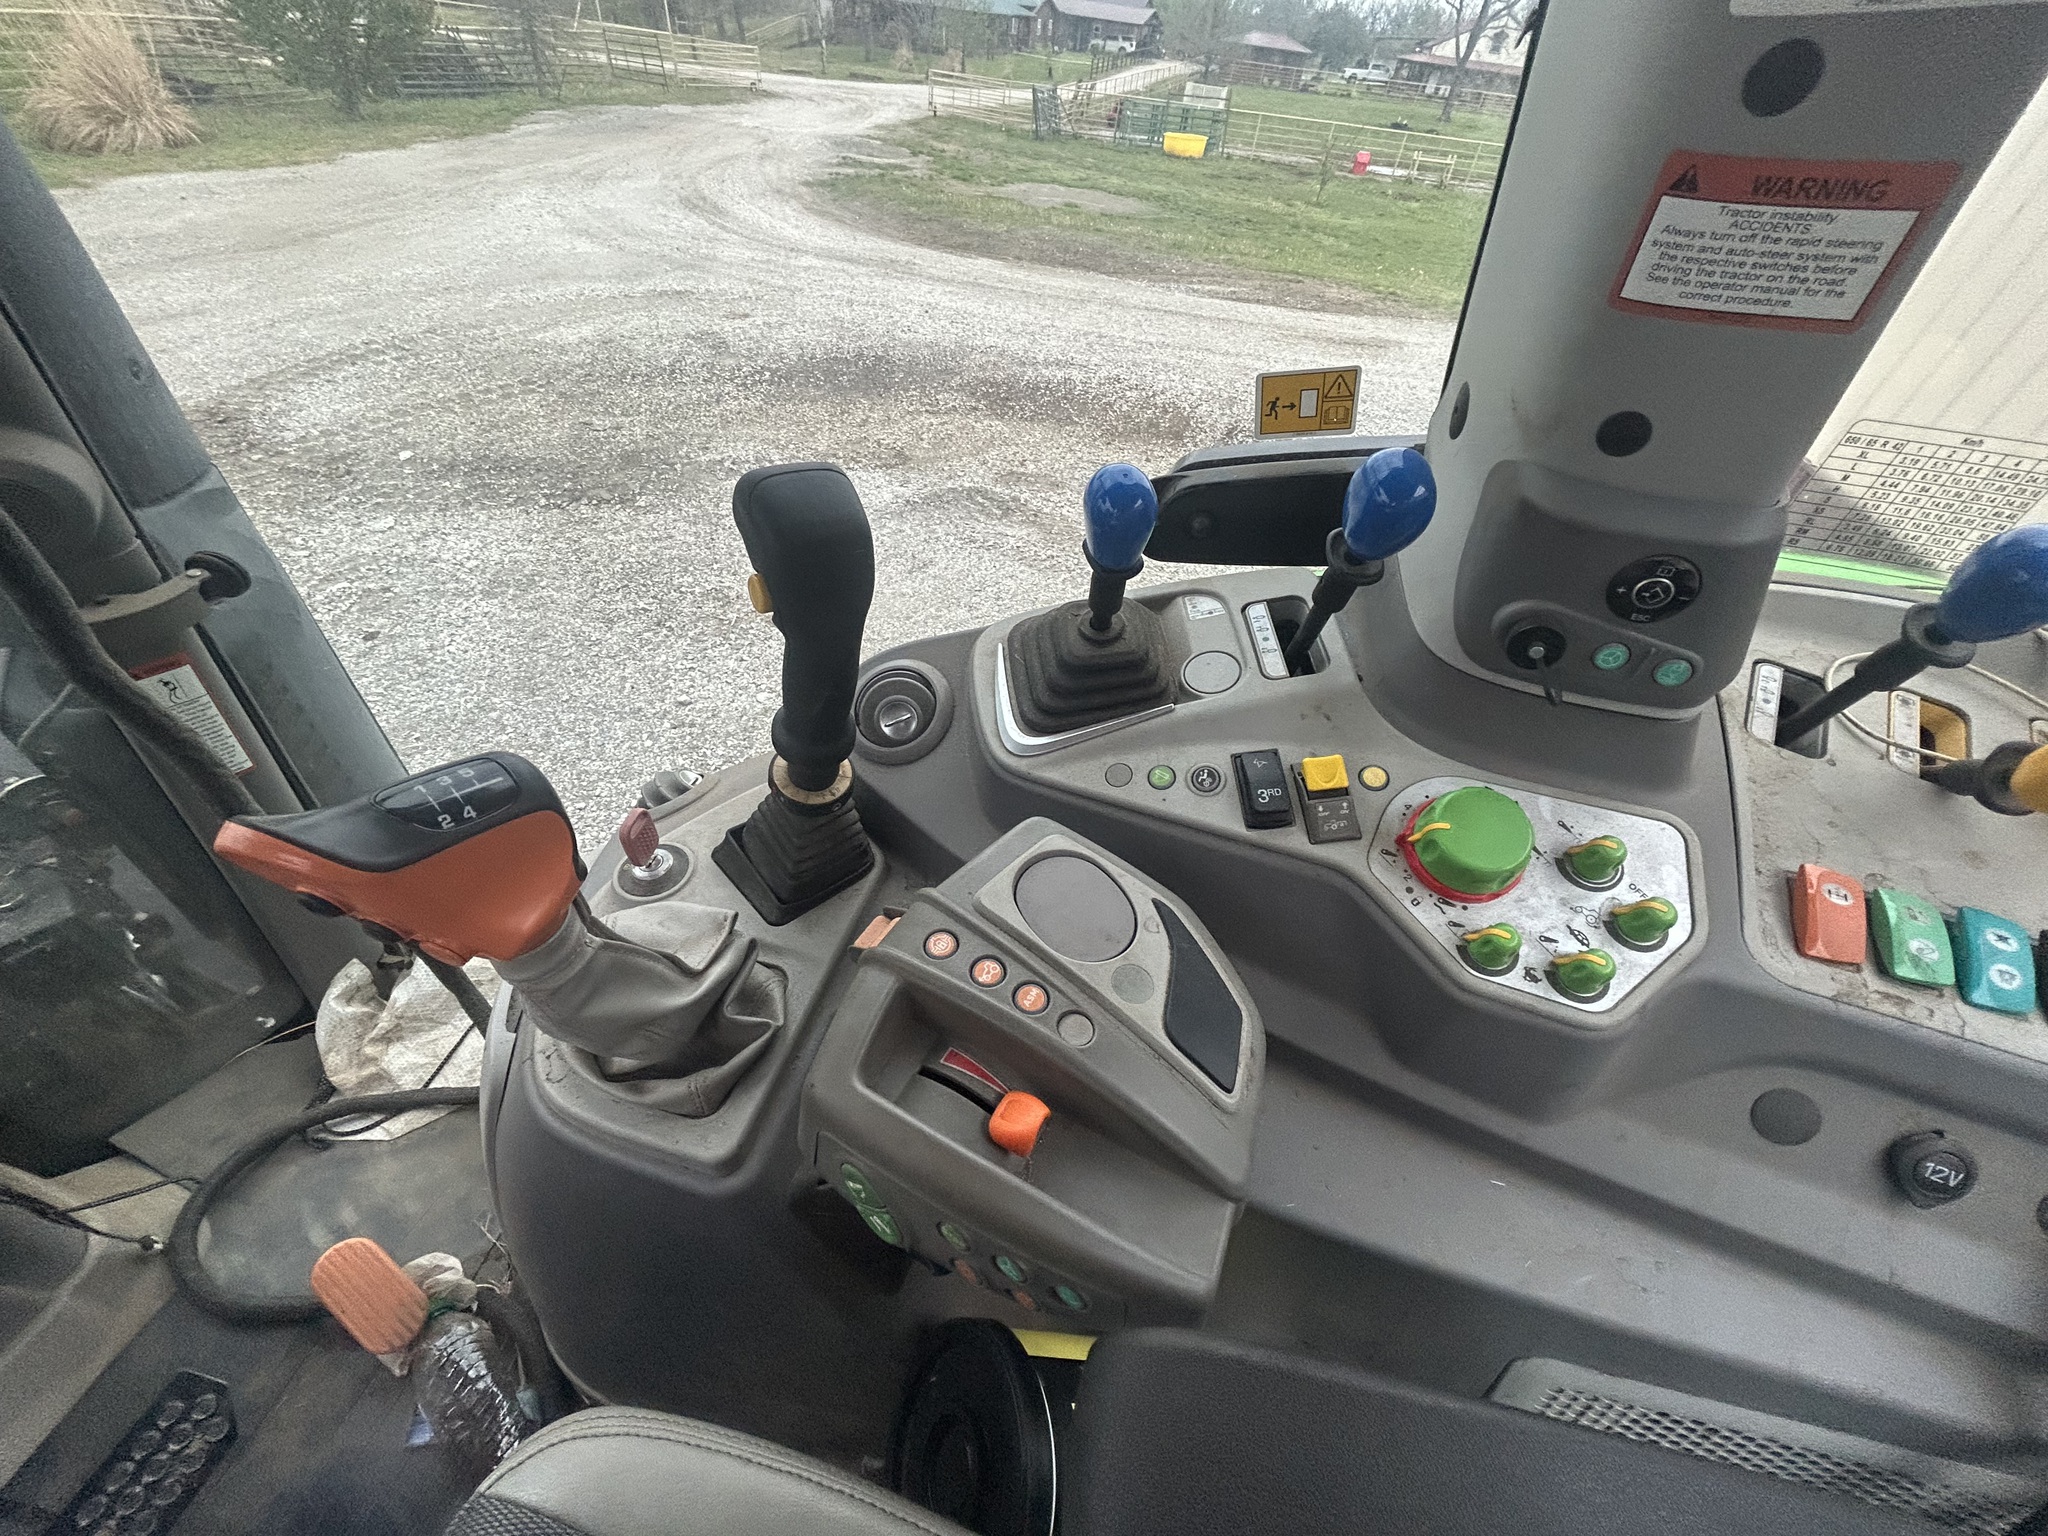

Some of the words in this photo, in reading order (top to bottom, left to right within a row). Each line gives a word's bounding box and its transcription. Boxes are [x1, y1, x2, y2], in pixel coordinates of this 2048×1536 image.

[1751, 175, 1890, 203] WARNING
[1719, 205, 1767, 219] Tractor
[1769, 208, 1840, 226] instability
[1728, 219, 1813, 235] ACCIDENTS
[1661, 224, 1707, 241] Always
[1709, 230, 1736, 242] turn
[1739, 232, 1760, 243] off
[1760, 234, 1783, 246] the
[1786, 236, 1824, 249] rapid
[1824, 239, 1885, 253] steering
[1650, 239, 1695, 251] system
[1696, 244, 1724, 256] and
[1725, 246, 1795, 261] auto-steer
[1796, 250, 1847, 264] system
[1850, 254, 1879, 265] with
[1658, 250, 1679, 262] the
[1680, 255, 1748, 270] respective
[1750, 261, 1810, 274] switches
[1811, 264, 1858, 277] before
[1646, 271, 1669, 284] See
[1671, 275, 1692, 288] the
[1694, 279, 1748, 293] operator
[1749, 284, 1800, 297] manual
[1803, 286, 1823, 298] for
[1824, 288, 1847, 299] the
[1650, 262, 1693, 277] driving
[1695, 267, 1717, 278] the
[1719, 269, 1763, 282] tractor
[1766, 273, 1784, 284] on
[1787, 274, 1810, 286] the
[1812, 277, 1848, 288] road.
[1678, 291, 1723, 303] correct
[1723, 294, 1794, 308] procedure.
[1630, 613, 1651, 622] ESC
[413, 785, 427, 794] 1
[436, 775, 452, 786] 3
[437, 814, 456, 830] 2
[463, 805, 477, 819] 4
[1403, 873, 1414, 882] 2
[1628, 883, 1649, 899] OFF
[1023, 988, 1041, 1008] ASM
[1924, 1162, 1965, 1187] 12V
